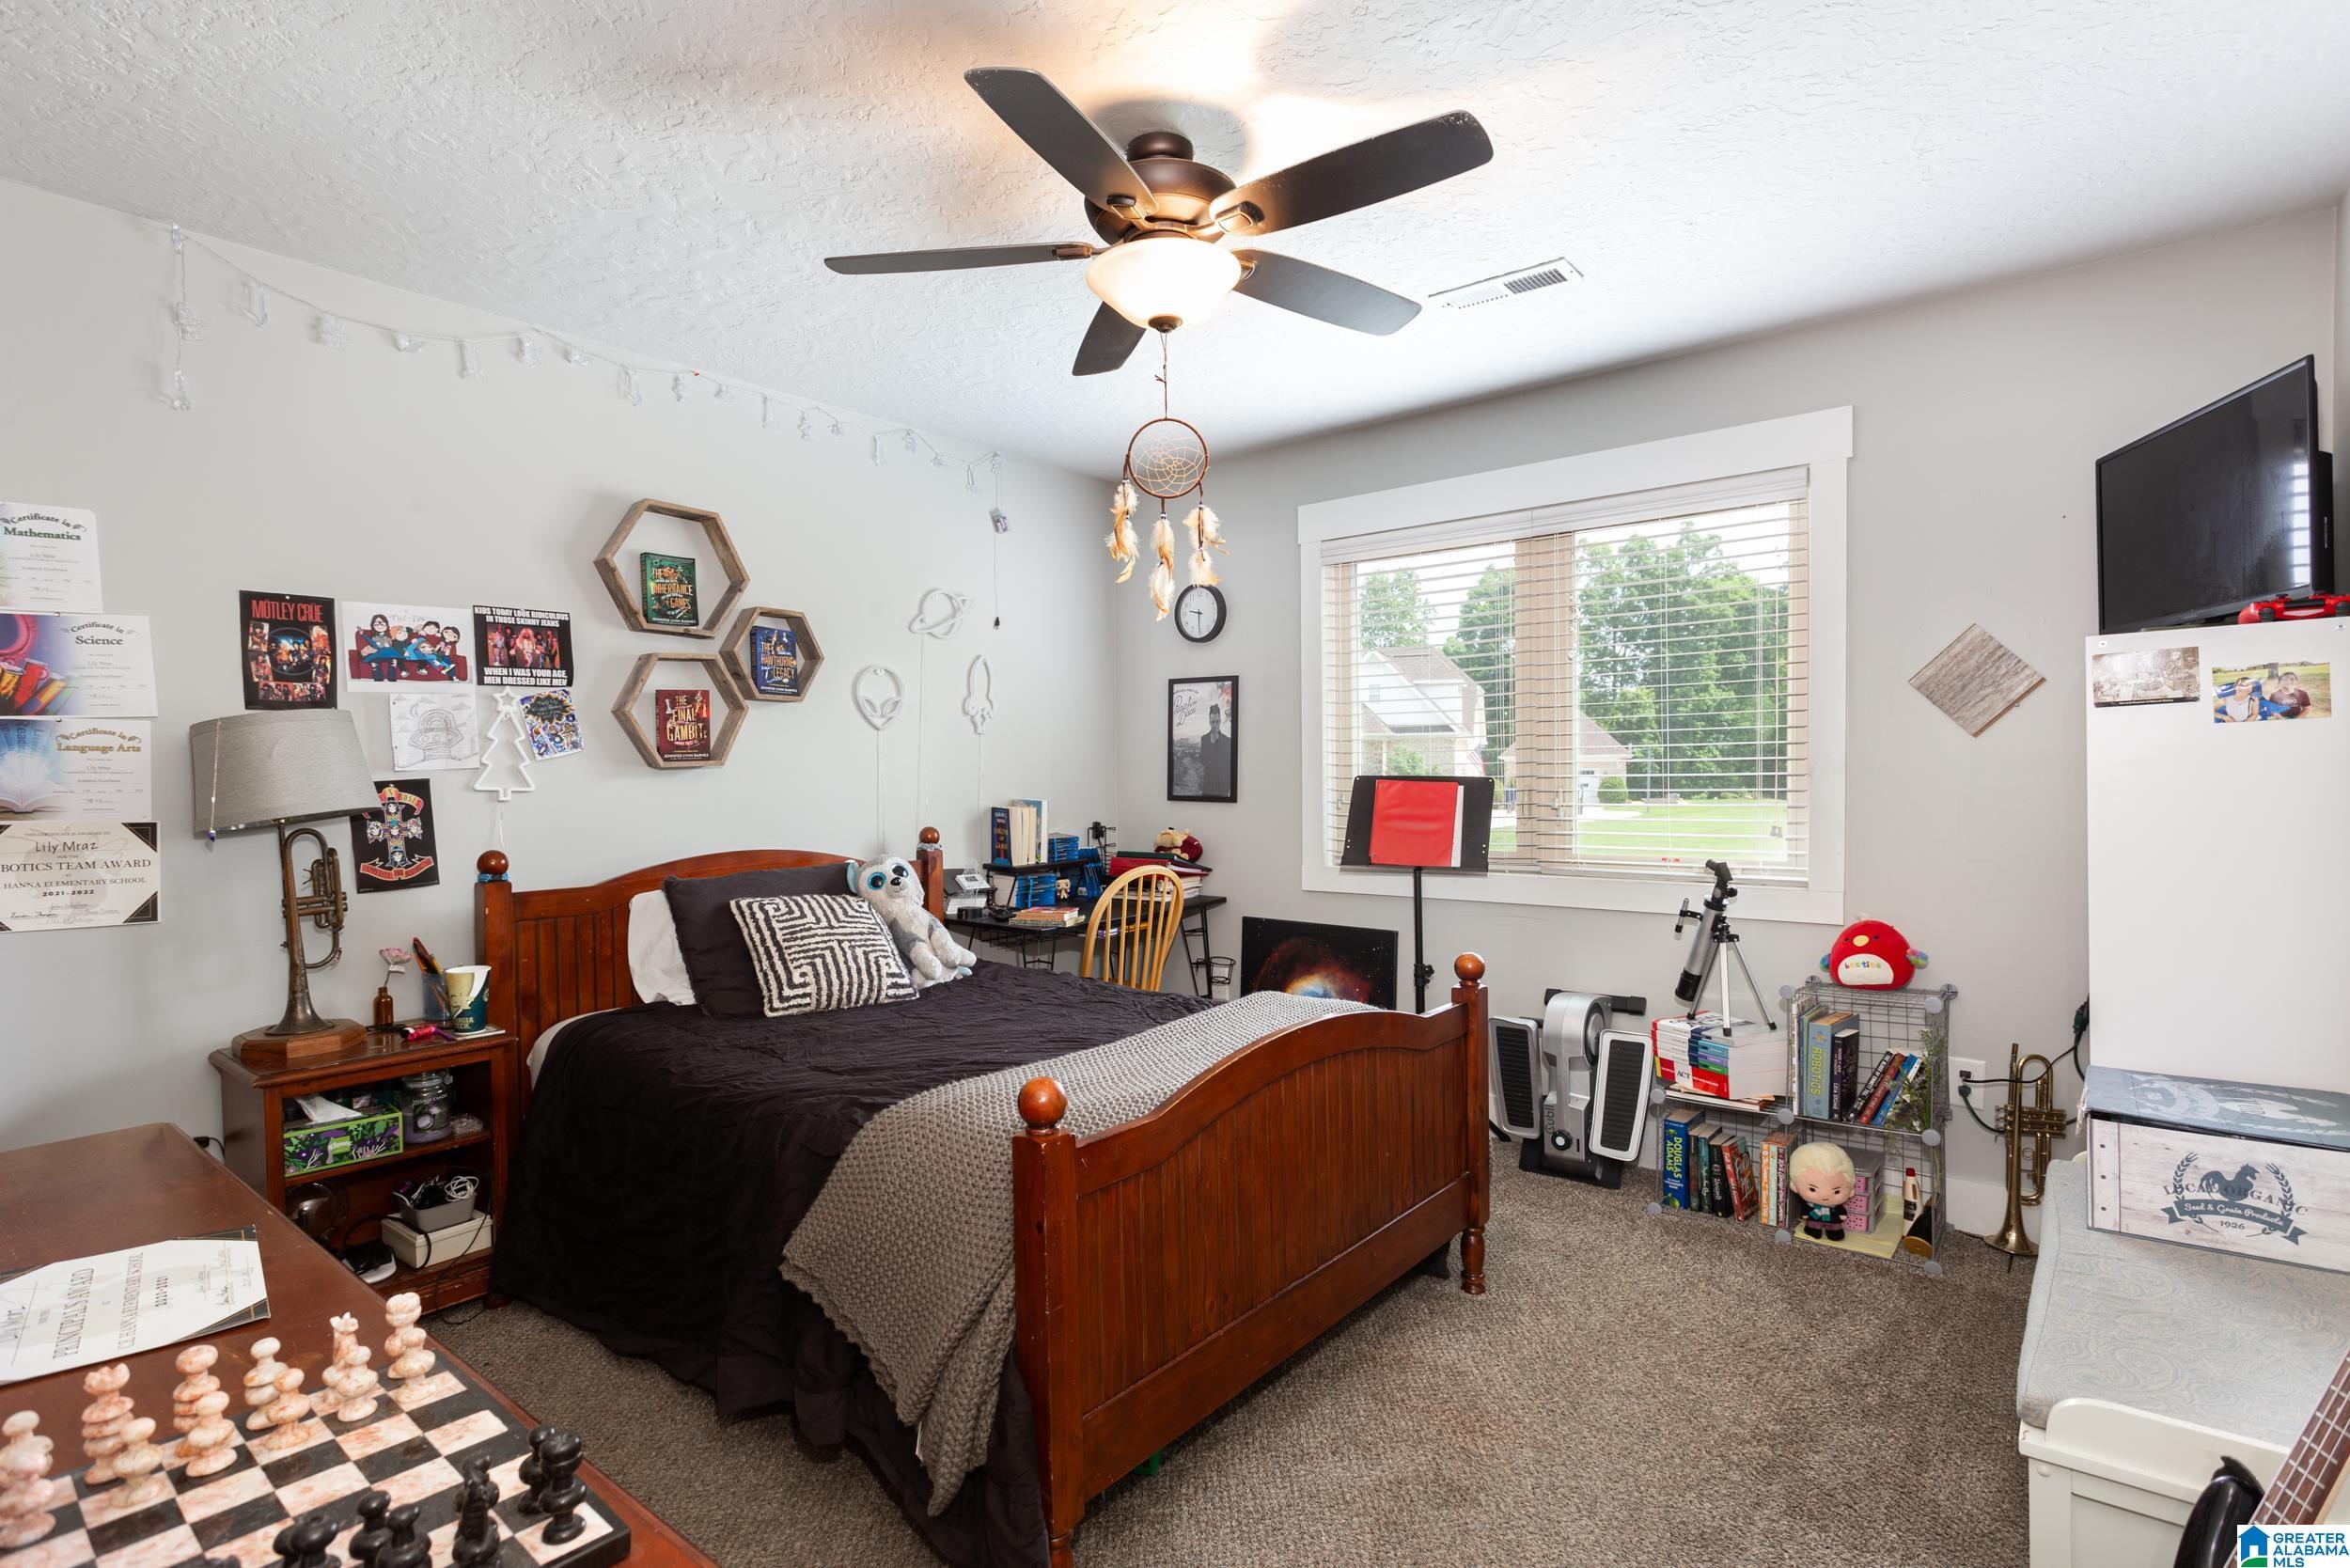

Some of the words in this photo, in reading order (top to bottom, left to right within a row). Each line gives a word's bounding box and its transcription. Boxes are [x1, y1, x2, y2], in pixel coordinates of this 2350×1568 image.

[10, 513, 59, 524] Certificate
[62, 519, 71, 527] in
[4, 526, 82, 541] Mathematics
[652, 568, 664, 579] THE
[650, 584, 694, 596] INHERITANCE
[513, 609, 530, 618] LOOK
[531, 611, 569, 620] RIDICULOUS
[70, 621, 114, 633] Certificate
[494, 616, 515, 624] THOSE
[516, 618, 540, 626] SKINNY
[75, 635, 123, 646] Science
[513, 667, 531, 676] WAS
[774, 667, 794, 679] LEGACY
[484, 676, 501, 684] MEN
[503, 676, 535, 685] DRESSED
[675, 696, 688, 705] THE
[672, 708, 697, 722] FINAL
[70, 728, 117, 740] Certificate
[666, 721, 703, 741] GAMBIT
[56, 740, 114, 754] Language
[117, 744, 142, 752] Arts
[36, 841, 58, 854] Lily
[63, 841, 98, 852] Mraz
[56, 861, 97, 870] TEAM
[99, 859, 151, 870] AWARD
[44, 879, 107, 887] ELEMENTARY
[109, 876, 147, 885] SCHOOL
[1677, 1071, 1690, 1079] ACT
[1810, 1047, 1822, 1095] ROBOTICS
[1674, 1137, 1683, 1178] DOUGLAS
[2225, 1185, 2308, 1216] ORGANC
[2185, 1203, 2205, 1212] Seed
[2217, 1204, 2244, 1215] Grain
[2219, 1220, 2246, 1231] 1926
[68, 1268, 94, 1299] AWARD
